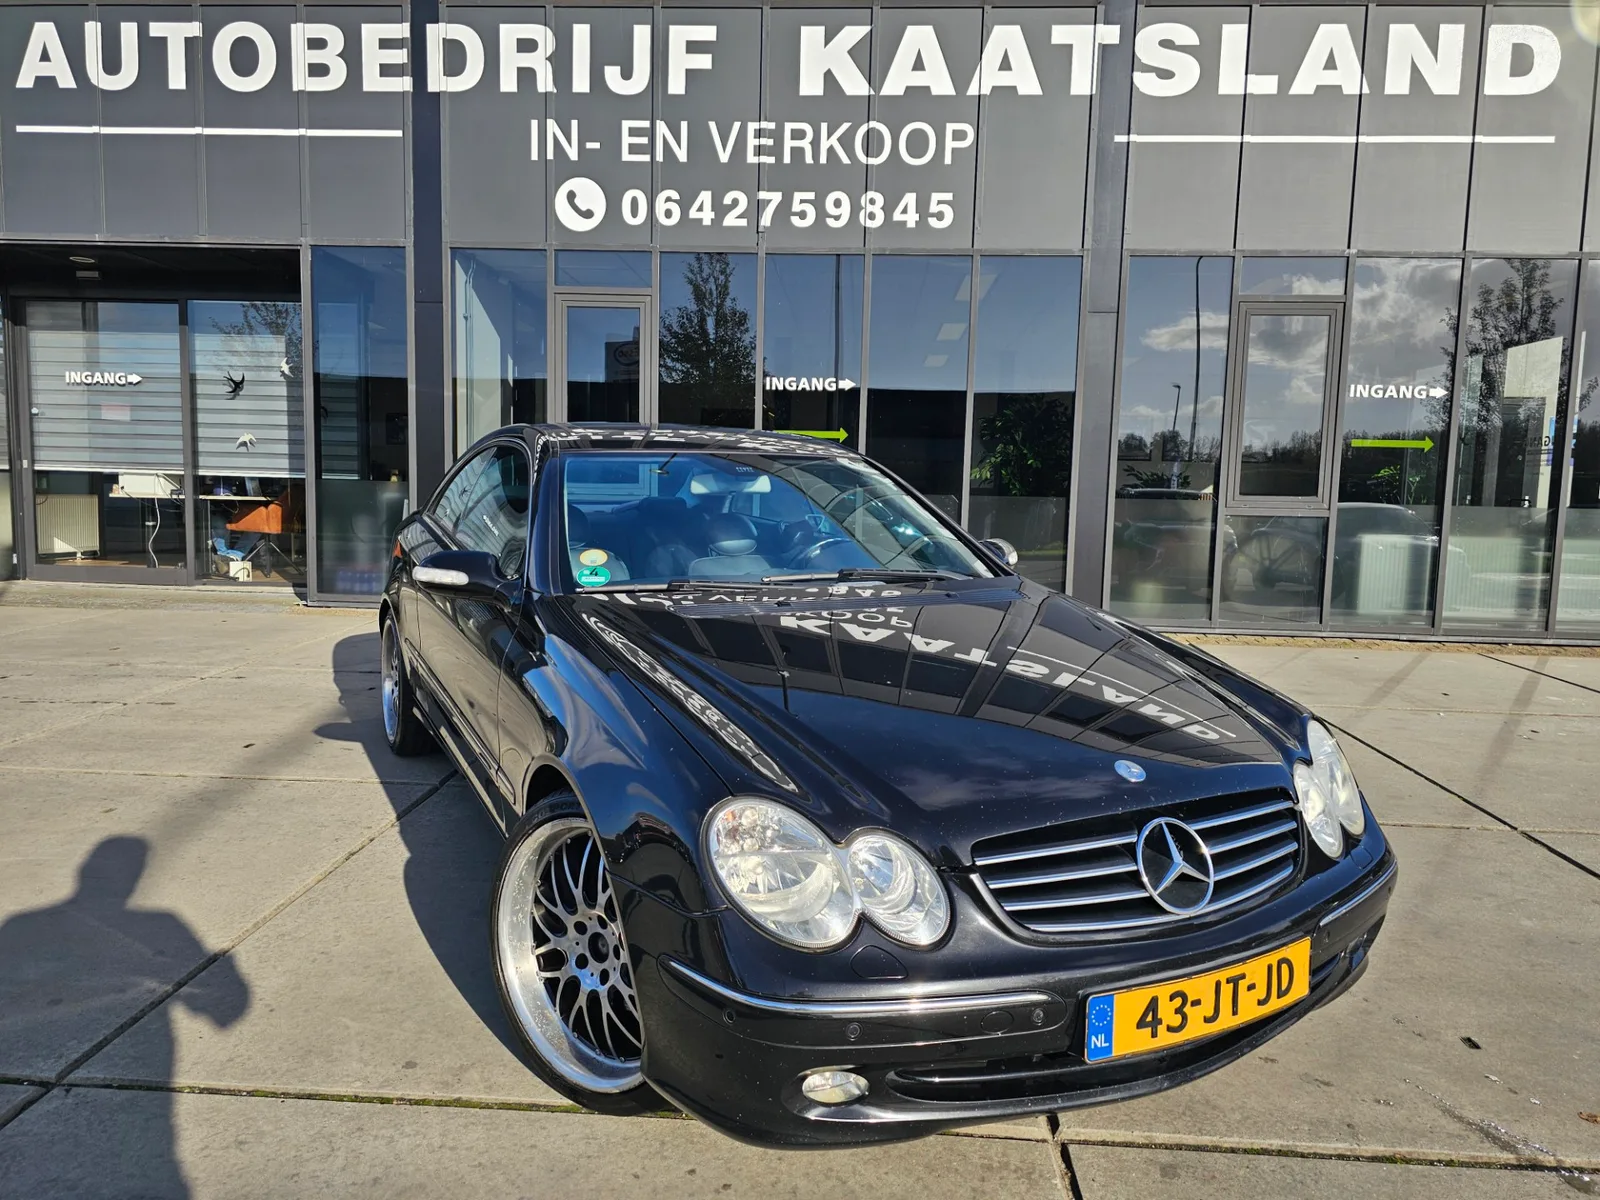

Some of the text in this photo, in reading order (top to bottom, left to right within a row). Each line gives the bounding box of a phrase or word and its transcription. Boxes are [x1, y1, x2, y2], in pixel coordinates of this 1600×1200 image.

[15, 20, 1563, 97] AUTOBEDRIJF KAATSLAND
[530, 118, 975, 166] IN- EN VERKOOP
[621, 189, 954, 229] 0642759845
[65, 371, 126, 385] INGANG
[765, 376, 837, 391] INGANG
[1349, 384, 1427, 399] INGANG
[590, 567, 598, 576] 4
[1091, 956, 1295, 1049] NL 43-JT-JD
